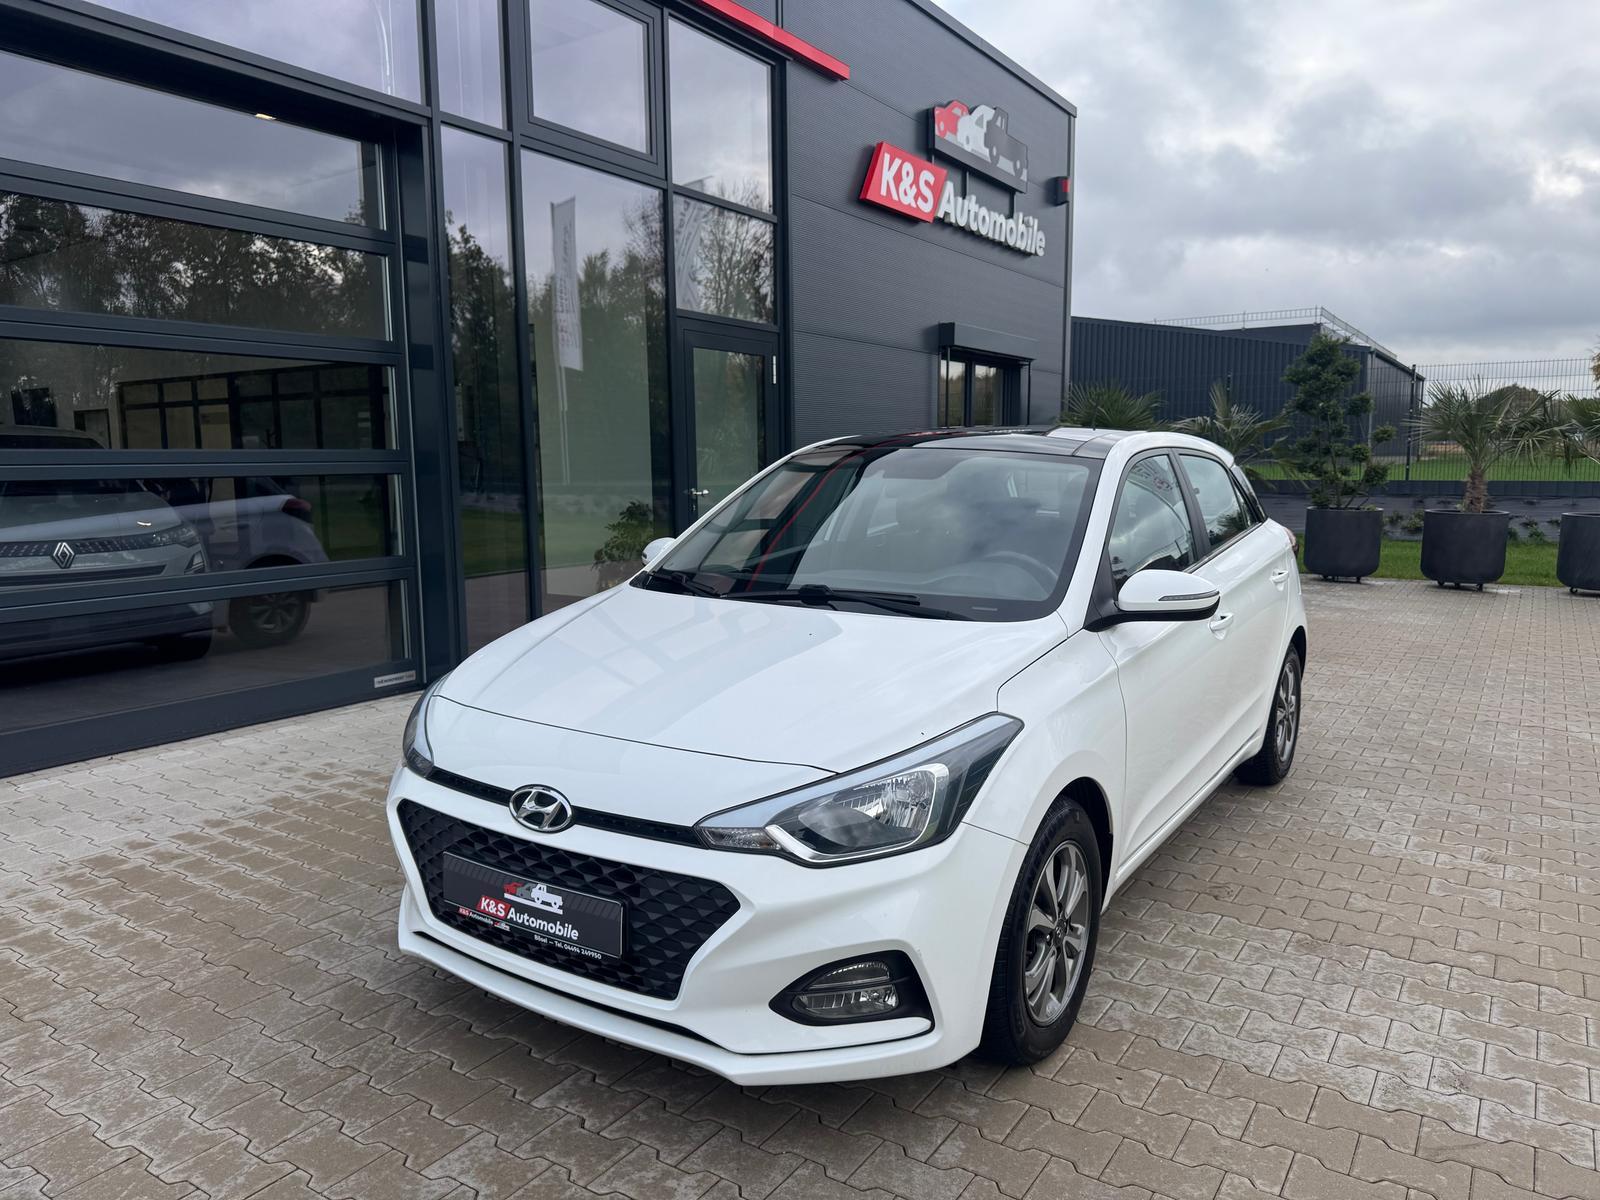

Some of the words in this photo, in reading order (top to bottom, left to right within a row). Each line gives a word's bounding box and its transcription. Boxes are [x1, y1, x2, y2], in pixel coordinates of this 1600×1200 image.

[880, 153, 935, 213] K&S
[937, 181, 1045, 256] Automobile
[480, 897, 505, 917] K&S
[507, 908, 579, 940] Automobile
[554, 940, 563, 949] Tel.
